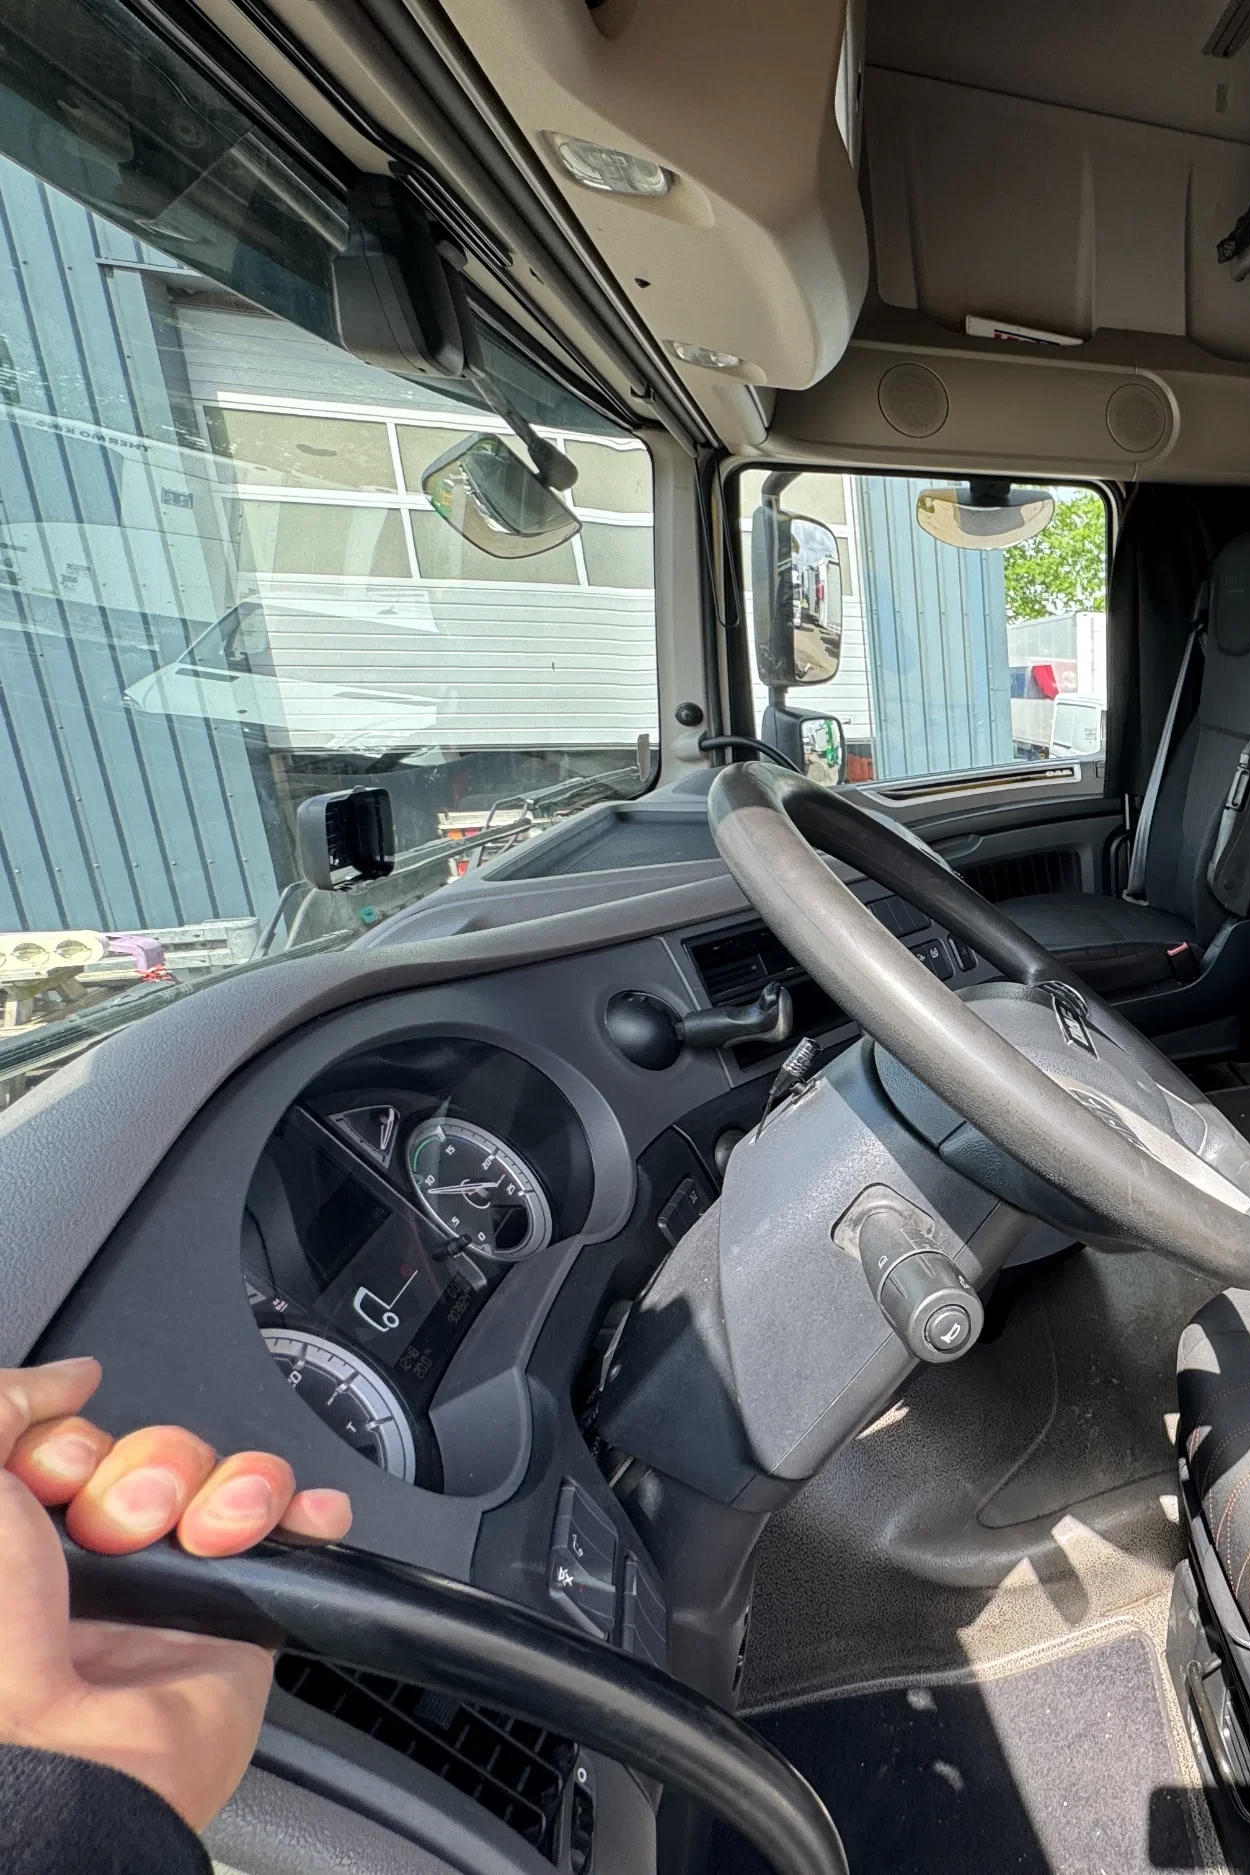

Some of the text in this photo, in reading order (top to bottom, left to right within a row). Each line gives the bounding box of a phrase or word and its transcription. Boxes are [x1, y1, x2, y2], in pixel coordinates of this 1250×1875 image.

[1045, 768, 1073, 777] DAF
[445, 1144, 456, 1155] 15
[481, 1158, 492, 1171] 20
[425, 1174, 436, 1186] 10
[506, 1182, 516, 1196] 25
[451, 1215, 460, 1227] 5
